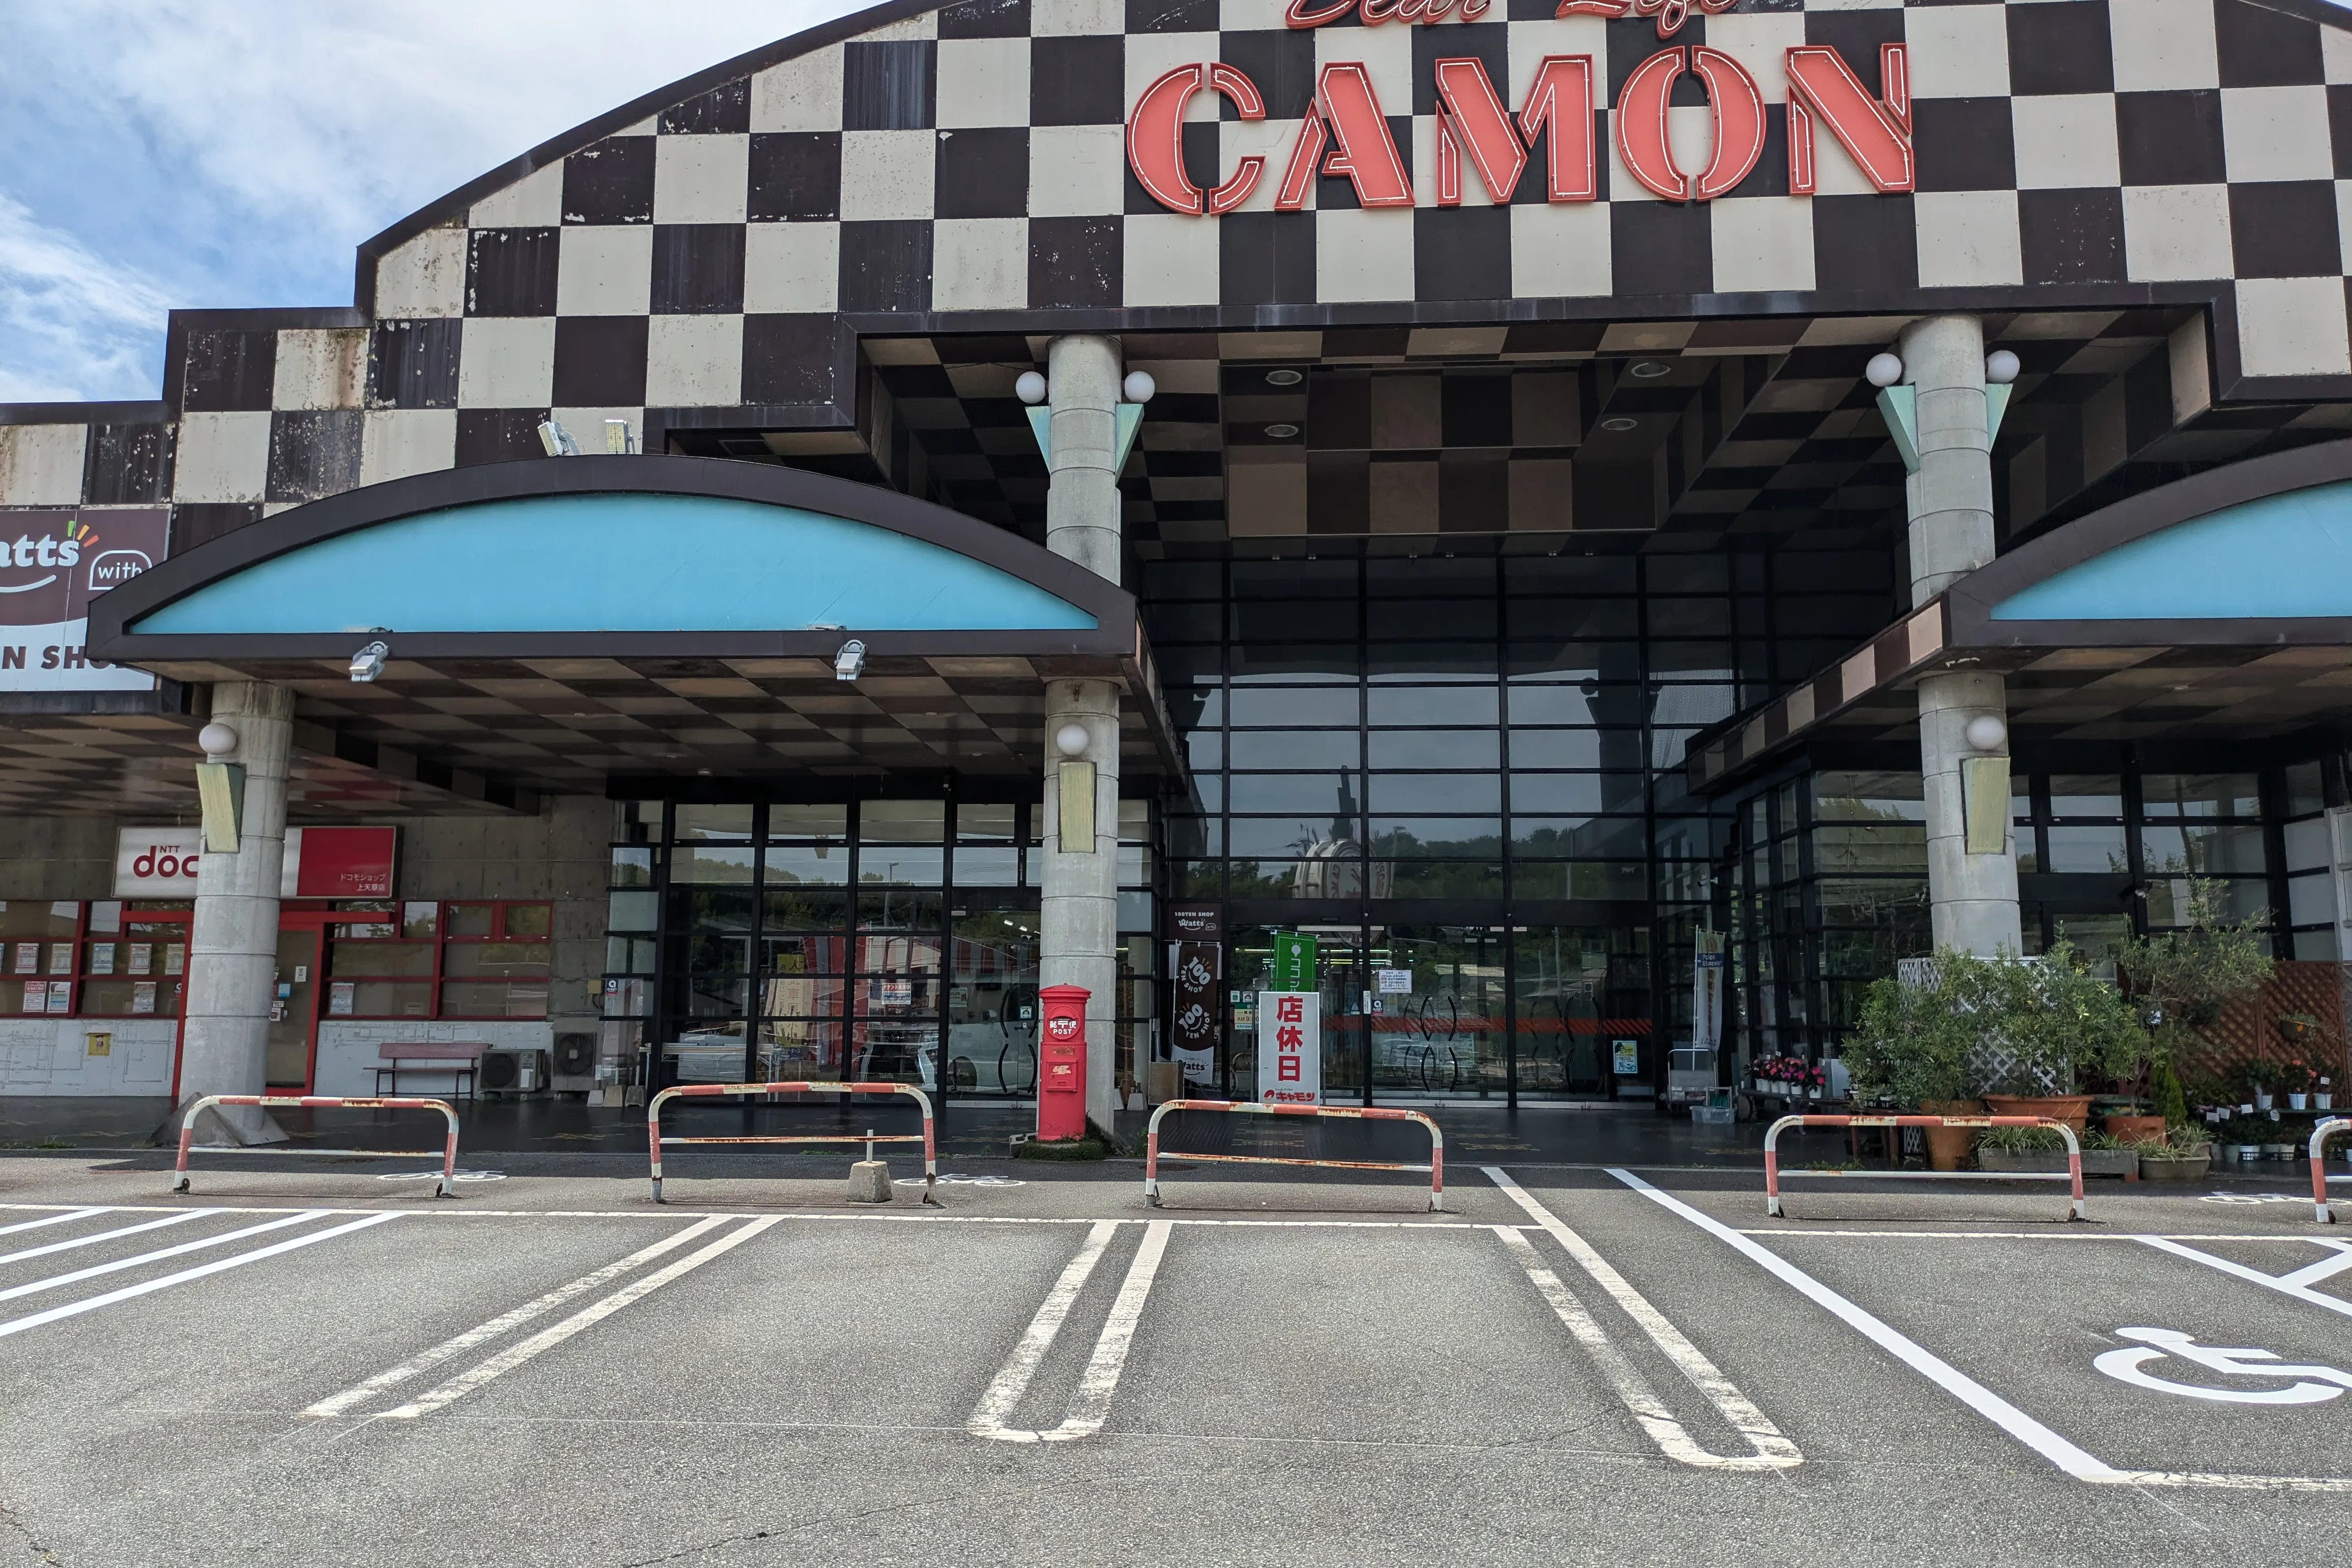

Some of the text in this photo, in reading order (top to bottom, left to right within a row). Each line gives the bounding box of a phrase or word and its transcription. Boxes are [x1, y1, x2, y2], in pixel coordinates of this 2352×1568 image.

[1126, 43, 1915, 216] CAMON
[341, 873, 387, 881] ドコモショップ
[1178, 919, 1204, 927] Watts
[1189, 956, 1211, 985] 100
[1184, 982, 1203, 993] SHOP
[1178, 1004, 1203, 1030] 100
[1186, 1030, 1199, 1039] YEN
[1200, 1012, 1210, 1034] SHOP
[1276, 996, 1304, 1082] 店休日
[1276, 1091, 1315, 1102] キャモン
